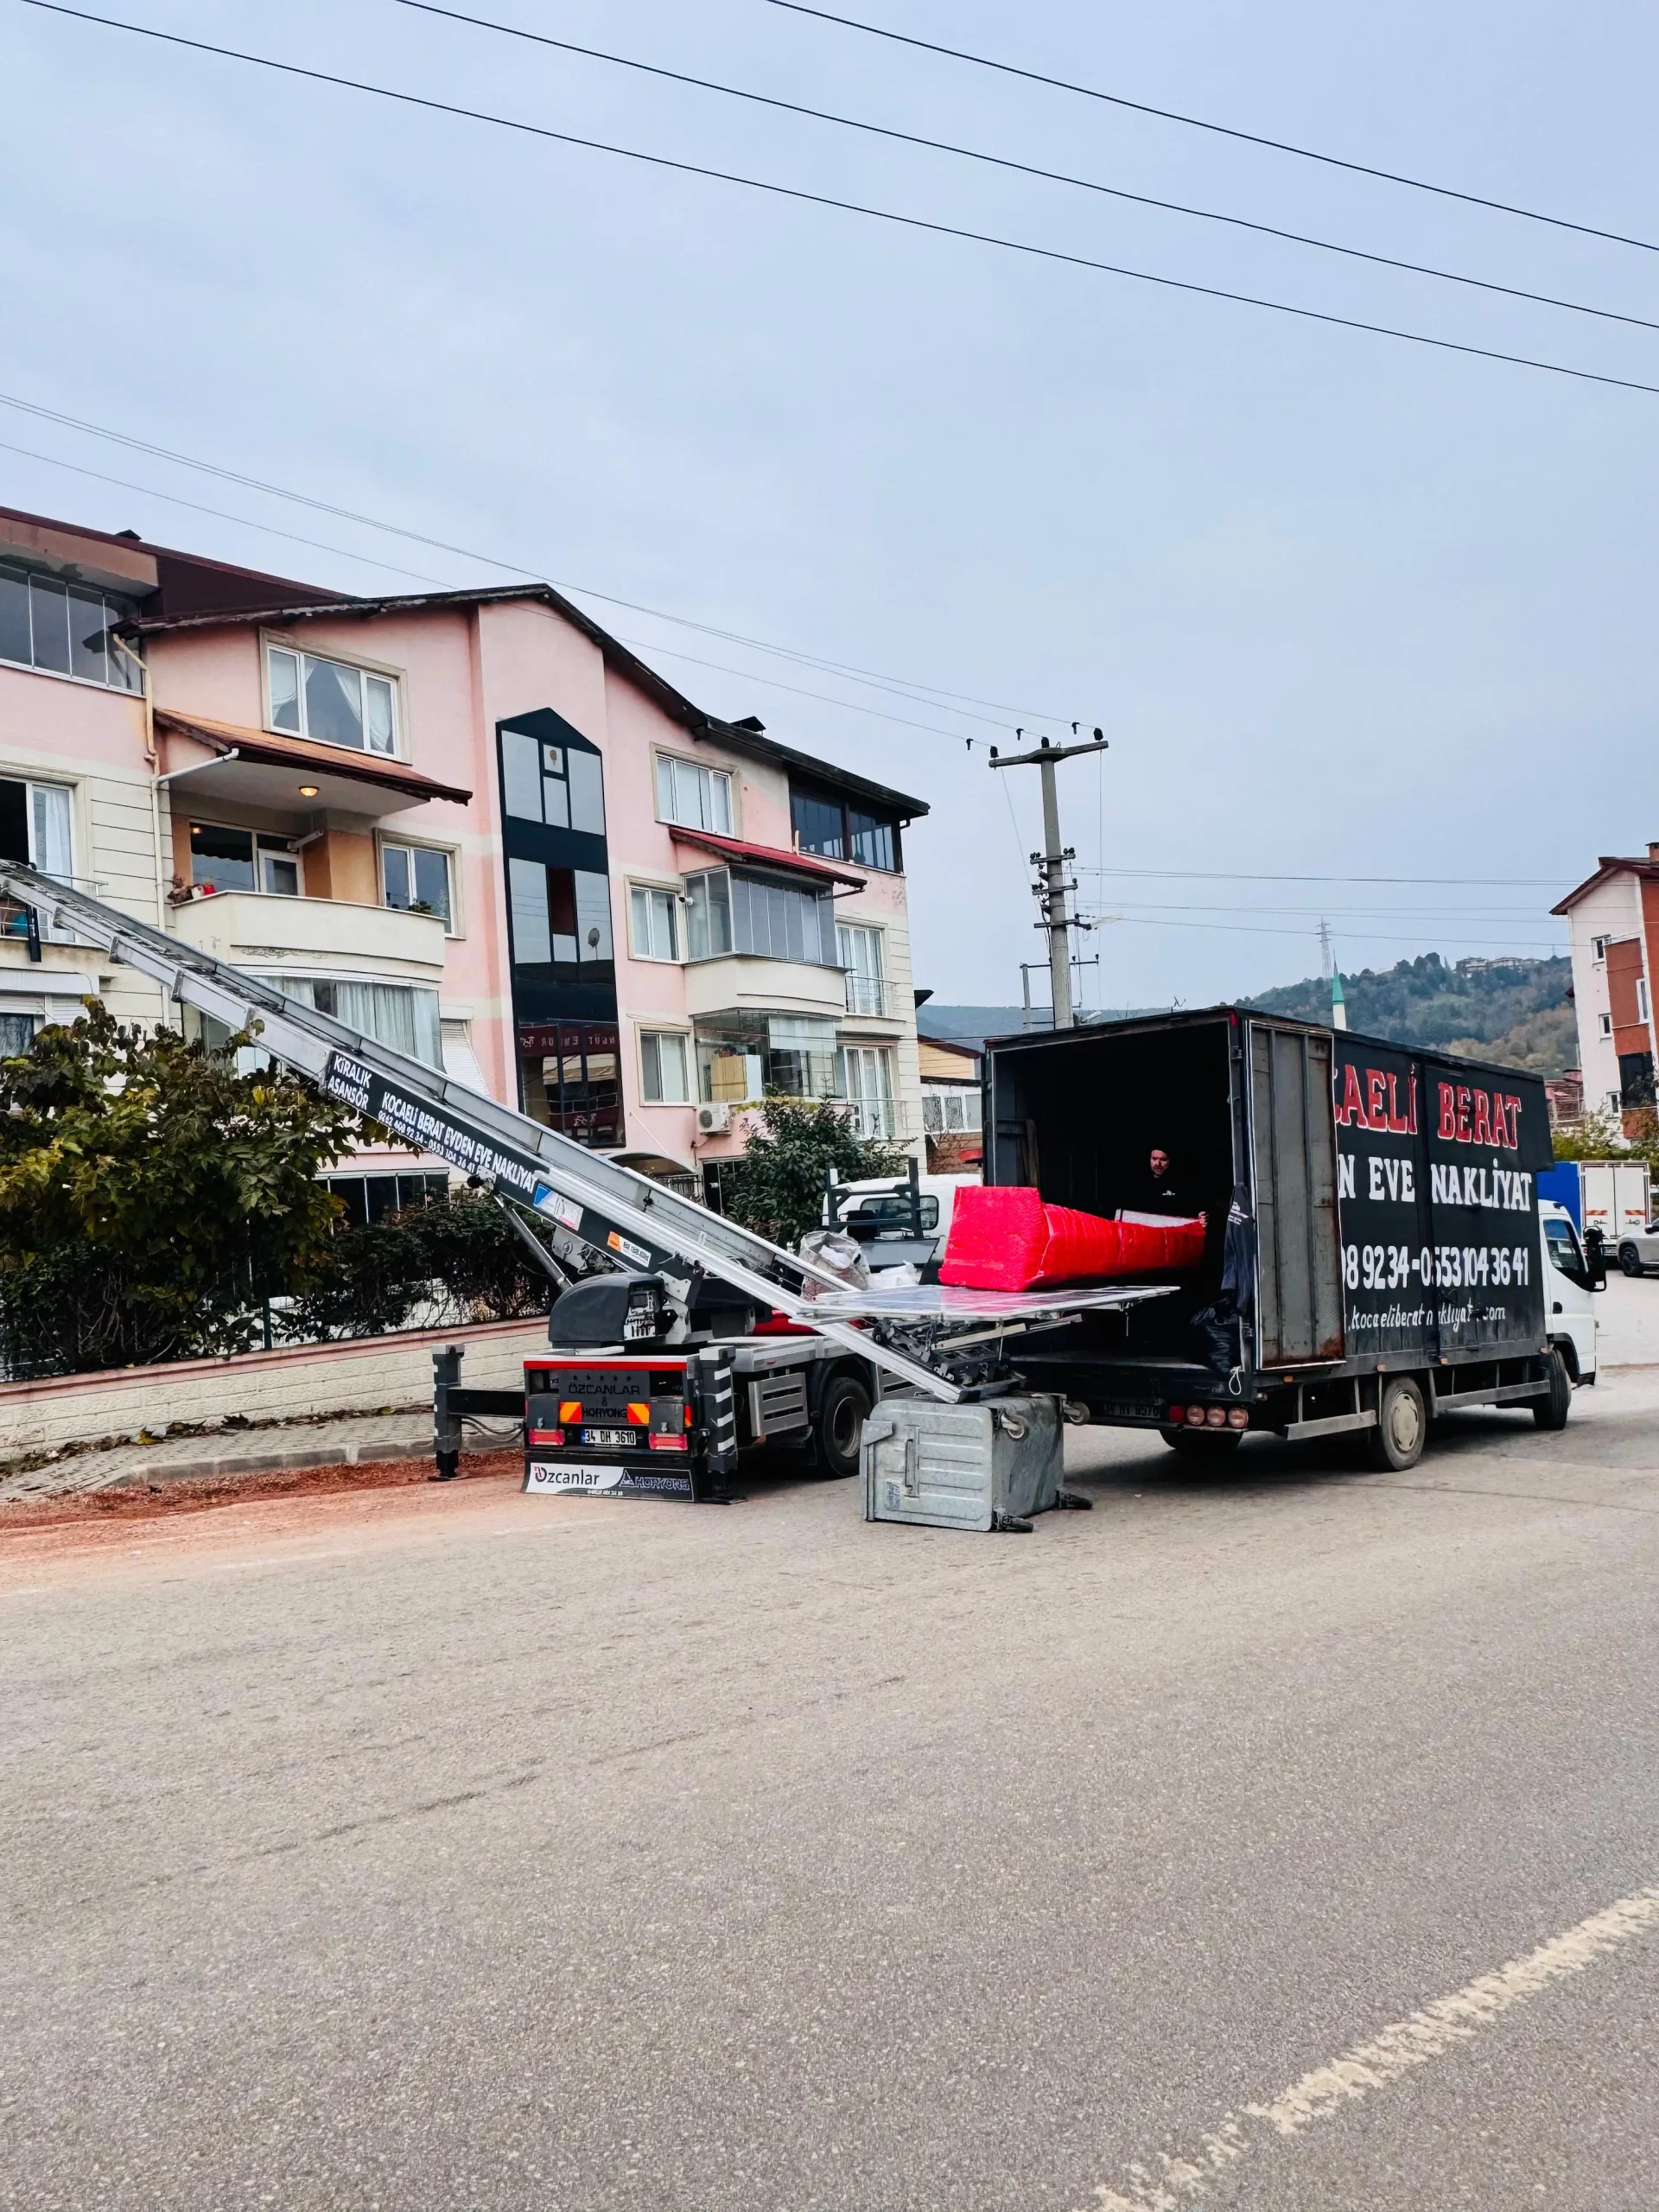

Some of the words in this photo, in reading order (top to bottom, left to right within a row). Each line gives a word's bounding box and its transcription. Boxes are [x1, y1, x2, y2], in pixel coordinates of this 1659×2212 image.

[334, 1054, 372, 1089] KİRALIK
[327, 1075, 369, 1110] ASANSÖR
[382, 1091, 419, 1126] KOCAELİ
[417, 1110, 445, 1141] BERAT
[444, 1126, 475, 1159] EVDEN
[474, 1142, 493, 1168] EVE
[1437, 1082, 1522, 1149] BERAT
[1368, 1156, 1415, 1202] EVE
[1431, 1158, 1532, 1211] NAKLİYAT
[568, 1382, 640, 1395] ÖZCANLAR
[585, 1430, 596, 1441] 34
[600, 1431, 611, 1442] DH
[614, 1431, 635, 1444] 3610
